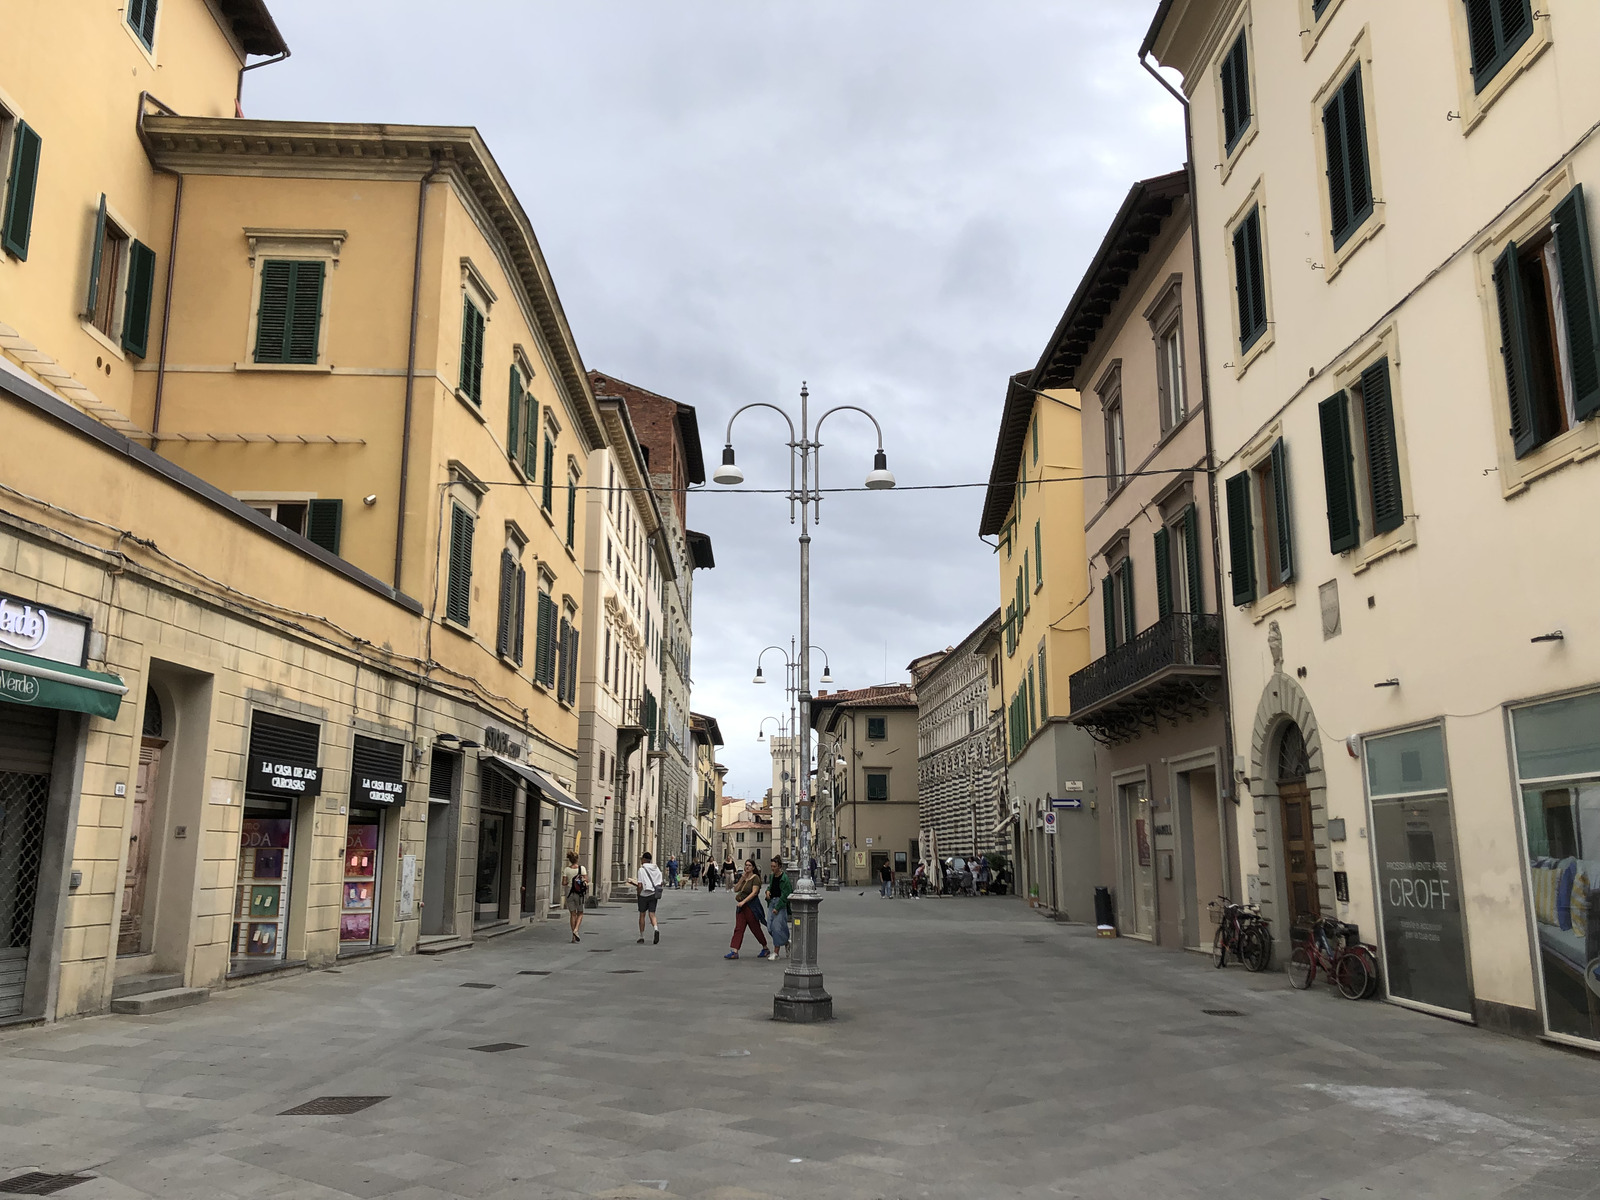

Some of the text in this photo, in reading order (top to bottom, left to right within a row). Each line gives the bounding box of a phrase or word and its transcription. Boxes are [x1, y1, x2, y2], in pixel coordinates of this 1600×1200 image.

[262, 762, 317, 781] LA CASA DE LAS
[271, 777, 306, 791] CARCASAS
[362, 778, 403, 793] LA CASA DE LAS
[369, 790, 395, 803] CARCASAS
[1389, 878, 1450, 910] CROFF
